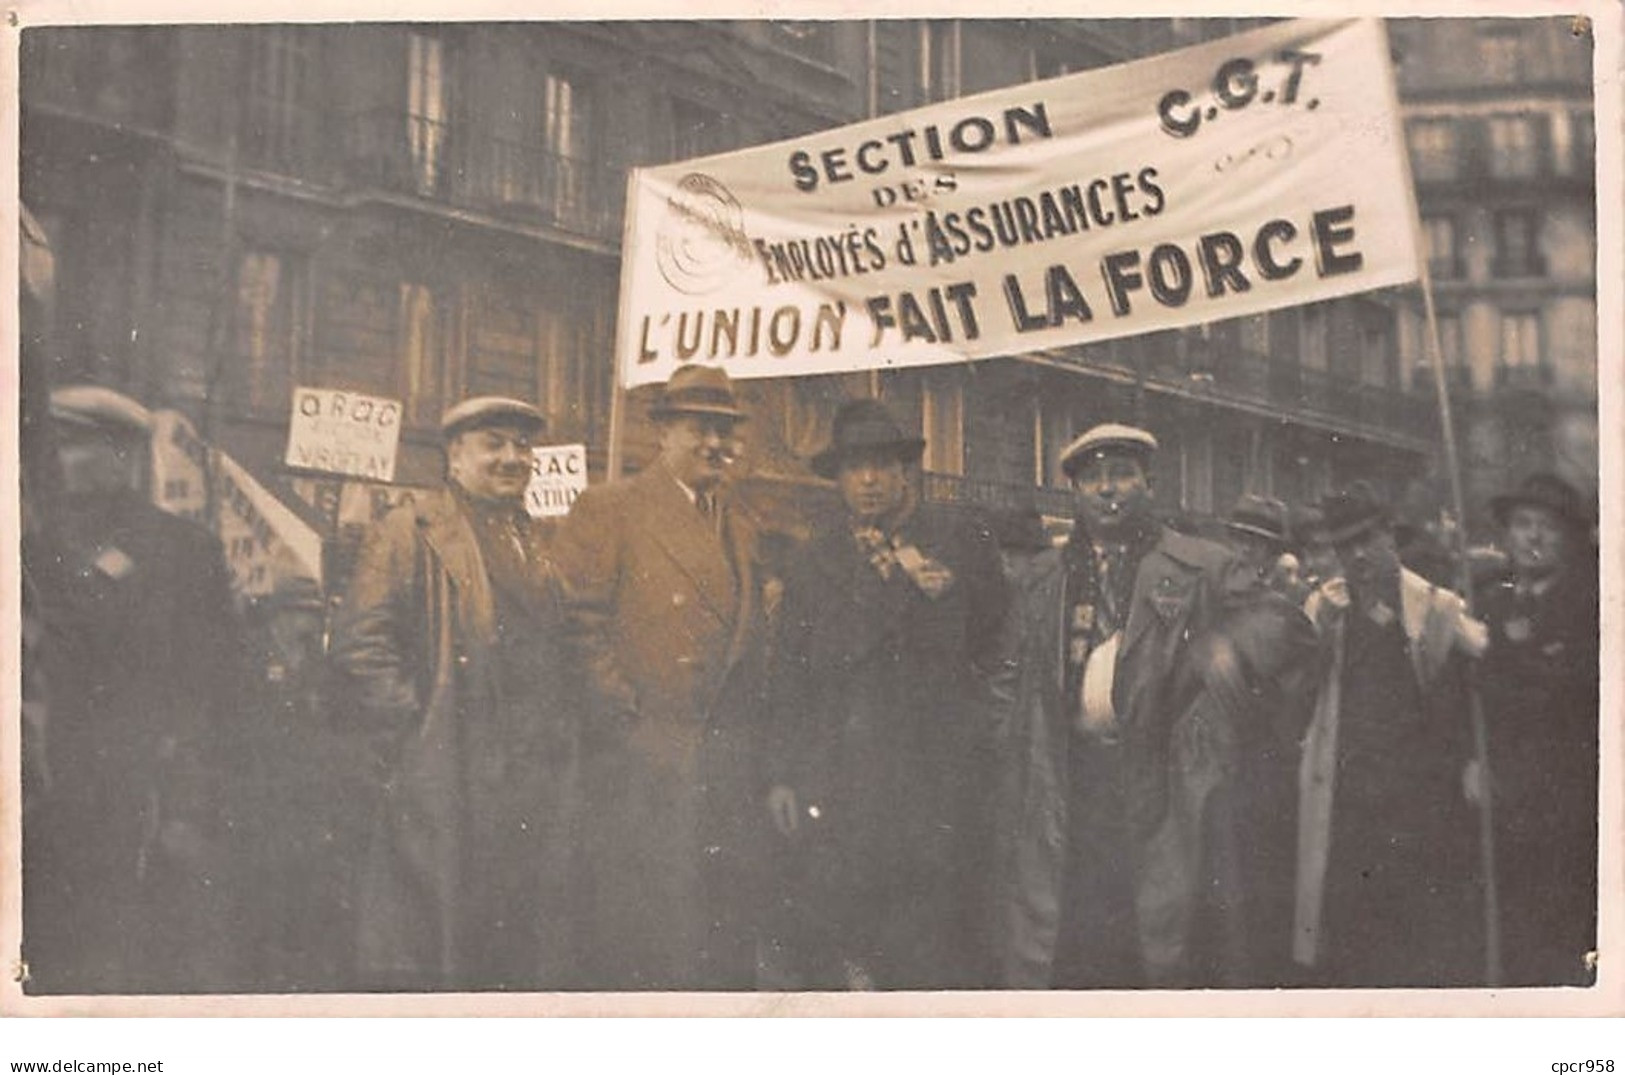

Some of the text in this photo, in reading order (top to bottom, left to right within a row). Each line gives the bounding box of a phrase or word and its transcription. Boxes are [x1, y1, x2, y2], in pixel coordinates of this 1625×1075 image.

[789, 50, 1322, 193] SECTION C.G.T.
[871, 173, 958, 208] DES
[637, 204, 1364, 364] L'UNION FAIT LA FORCE
